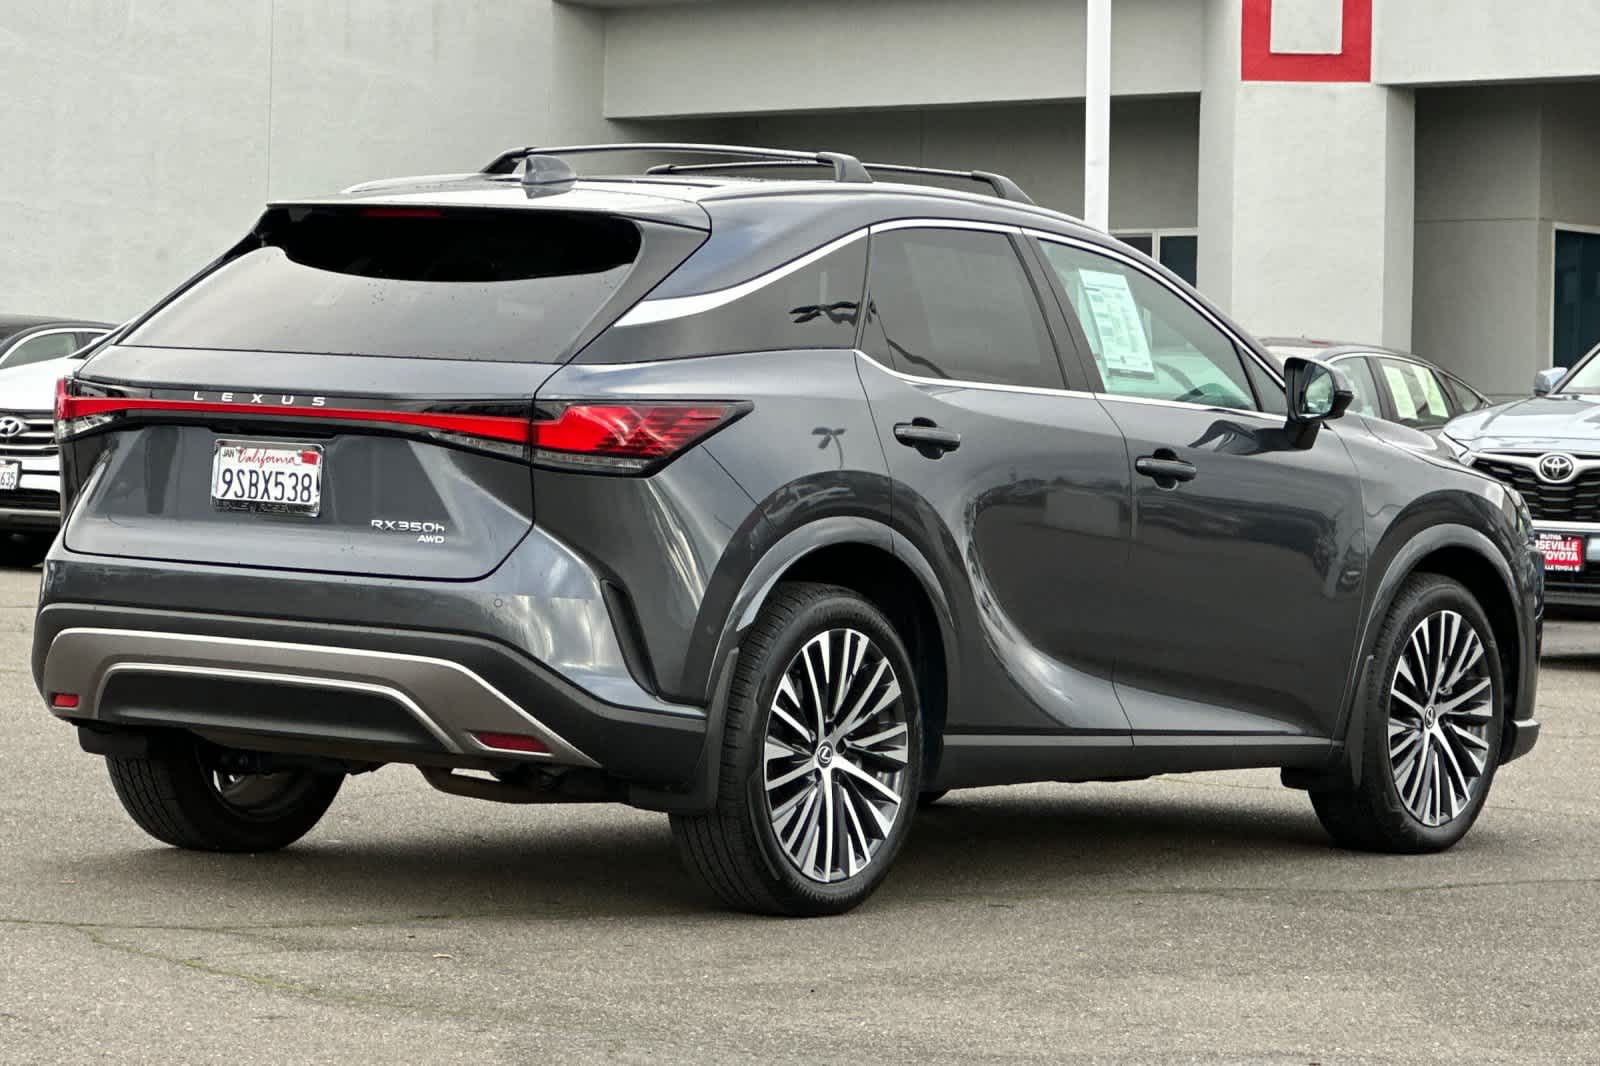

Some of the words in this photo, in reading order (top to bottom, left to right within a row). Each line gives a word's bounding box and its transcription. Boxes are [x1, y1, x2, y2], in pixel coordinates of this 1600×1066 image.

[193, 391, 326, 406] LEXUS
[222, 448, 235, 458] JAN
[237, 448, 296, 468] California
[220, 468, 313, 503] 9SBX538
[371, 519, 445, 533] RX350h
[417, 534, 445, 544] AWD
